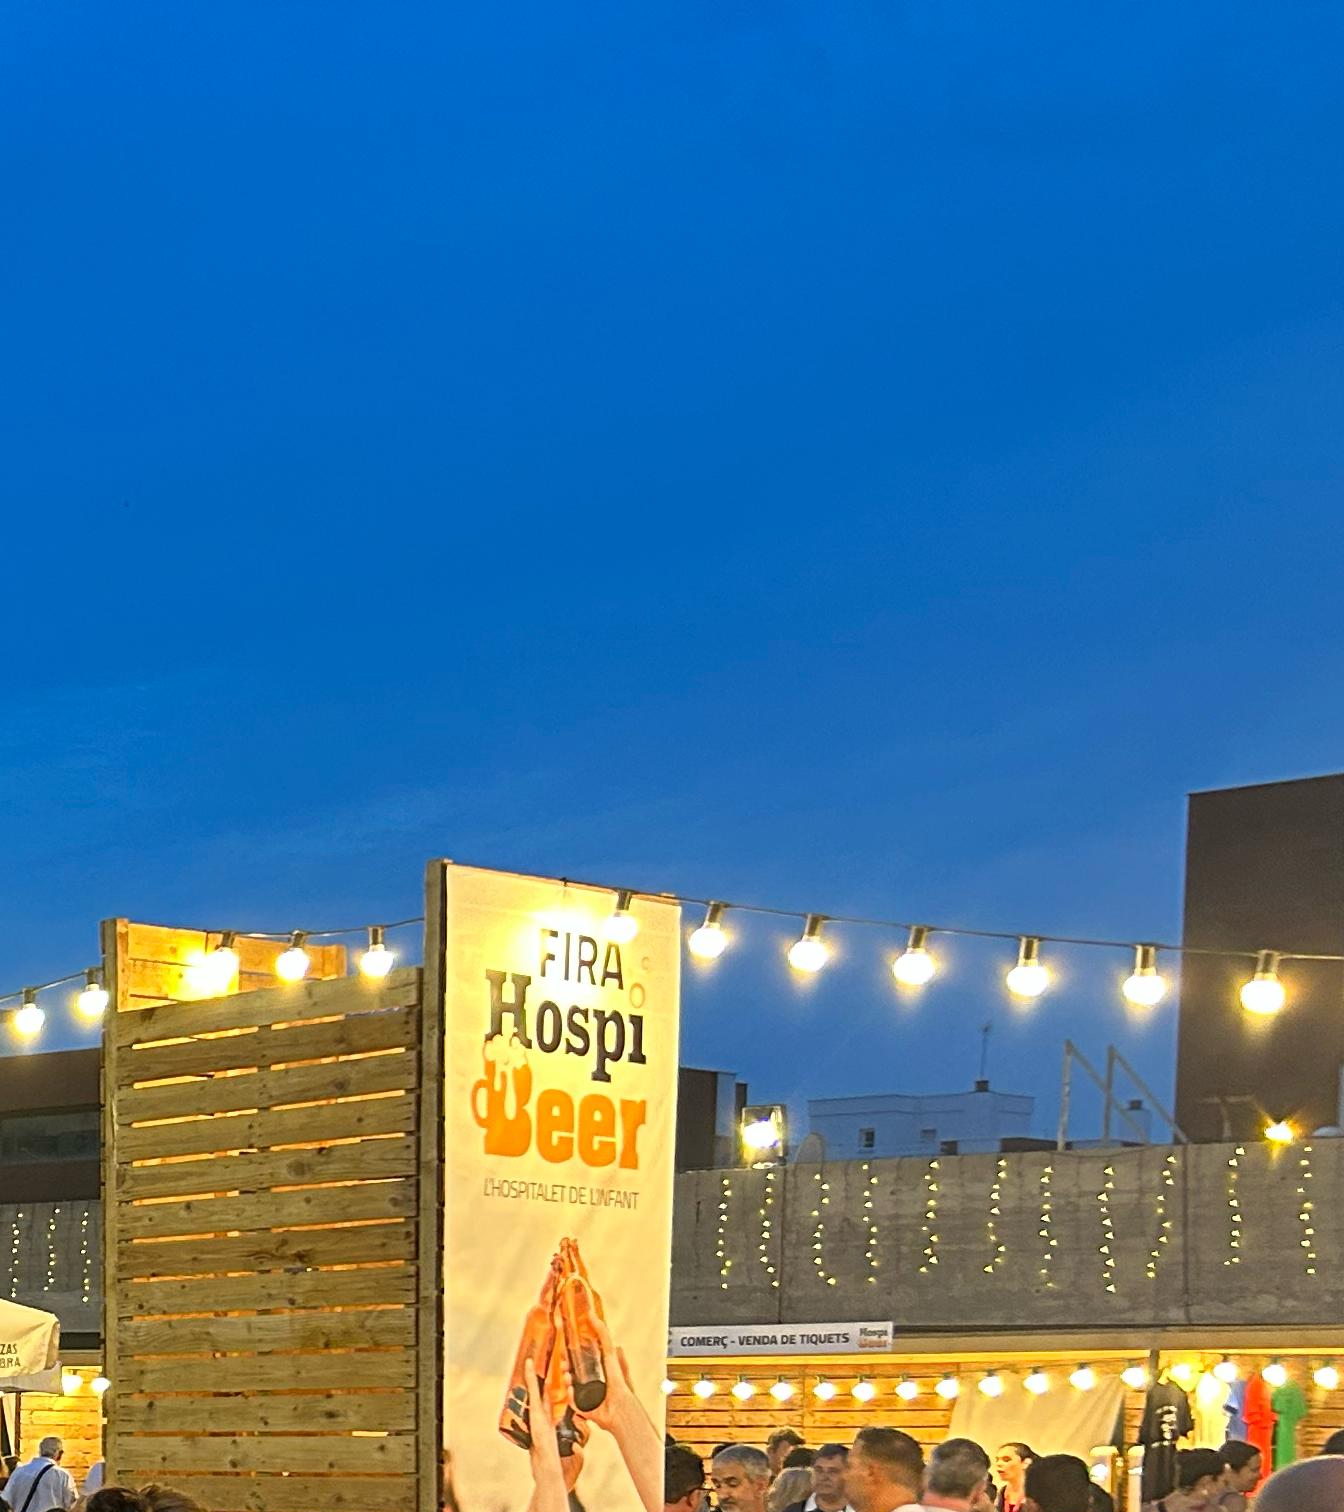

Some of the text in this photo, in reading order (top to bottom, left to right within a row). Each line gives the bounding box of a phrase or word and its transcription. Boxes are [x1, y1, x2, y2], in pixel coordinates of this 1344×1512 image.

[540, 928, 624, 990] FIRA
[485, 968, 647, 1083] Hospi
[471, 1056, 647, 1170] Beer
[483, 1177, 566, 1204] L'HOSPITALET
[568, 1184, 587, 1205] DE
[680, 1336, 728, 1350] COMERÇ
[738, 1335, 778, 1347] VENDA
[781, 1334, 796, 1345] DE
[800, 1332, 850, 1345] TIQUETS
